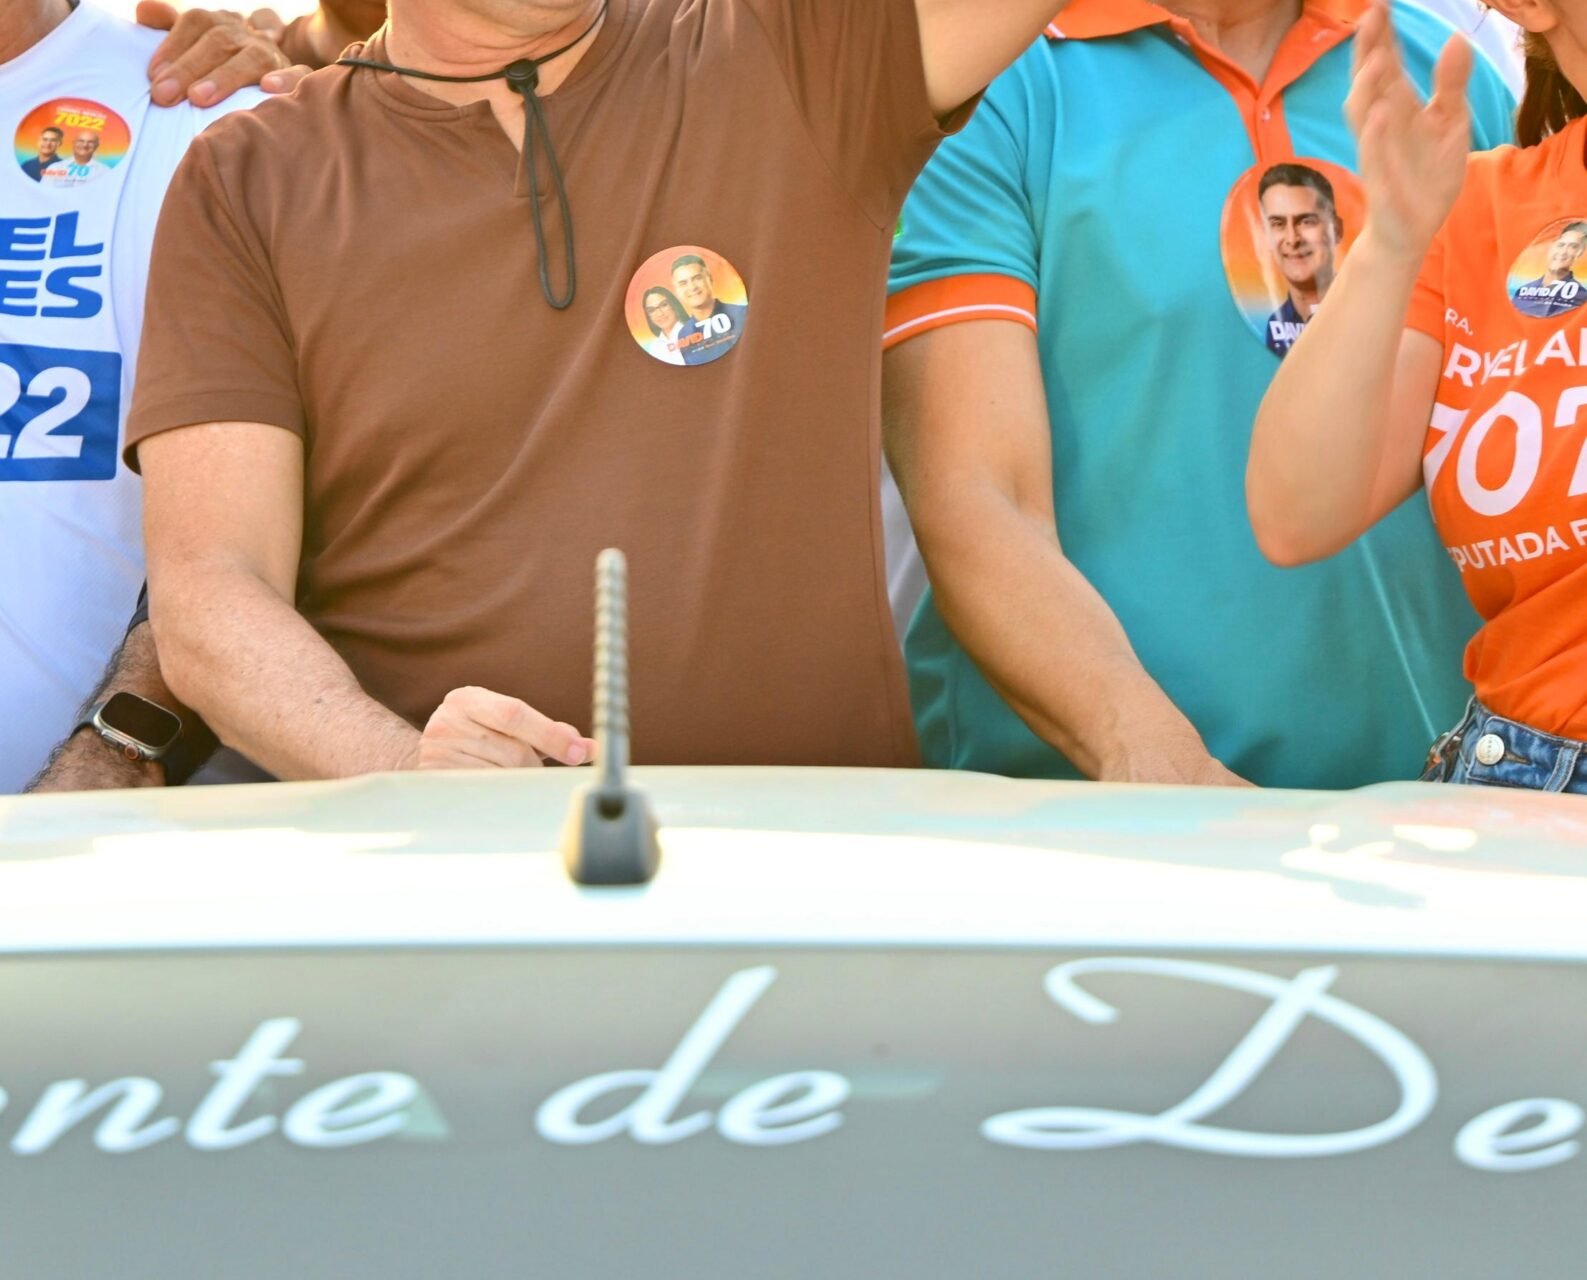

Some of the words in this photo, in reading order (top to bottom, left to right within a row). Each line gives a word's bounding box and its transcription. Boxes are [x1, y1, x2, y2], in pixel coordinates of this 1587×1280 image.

[54, 111, 106, 132] 7022
[67, 163, 90, 177] 70
[1549, 279, 1579, 300] 70
[694, 313, 732, 340] 70
[535, 964, 852, 1145] de
[979, 957, 1587, 1171] De
